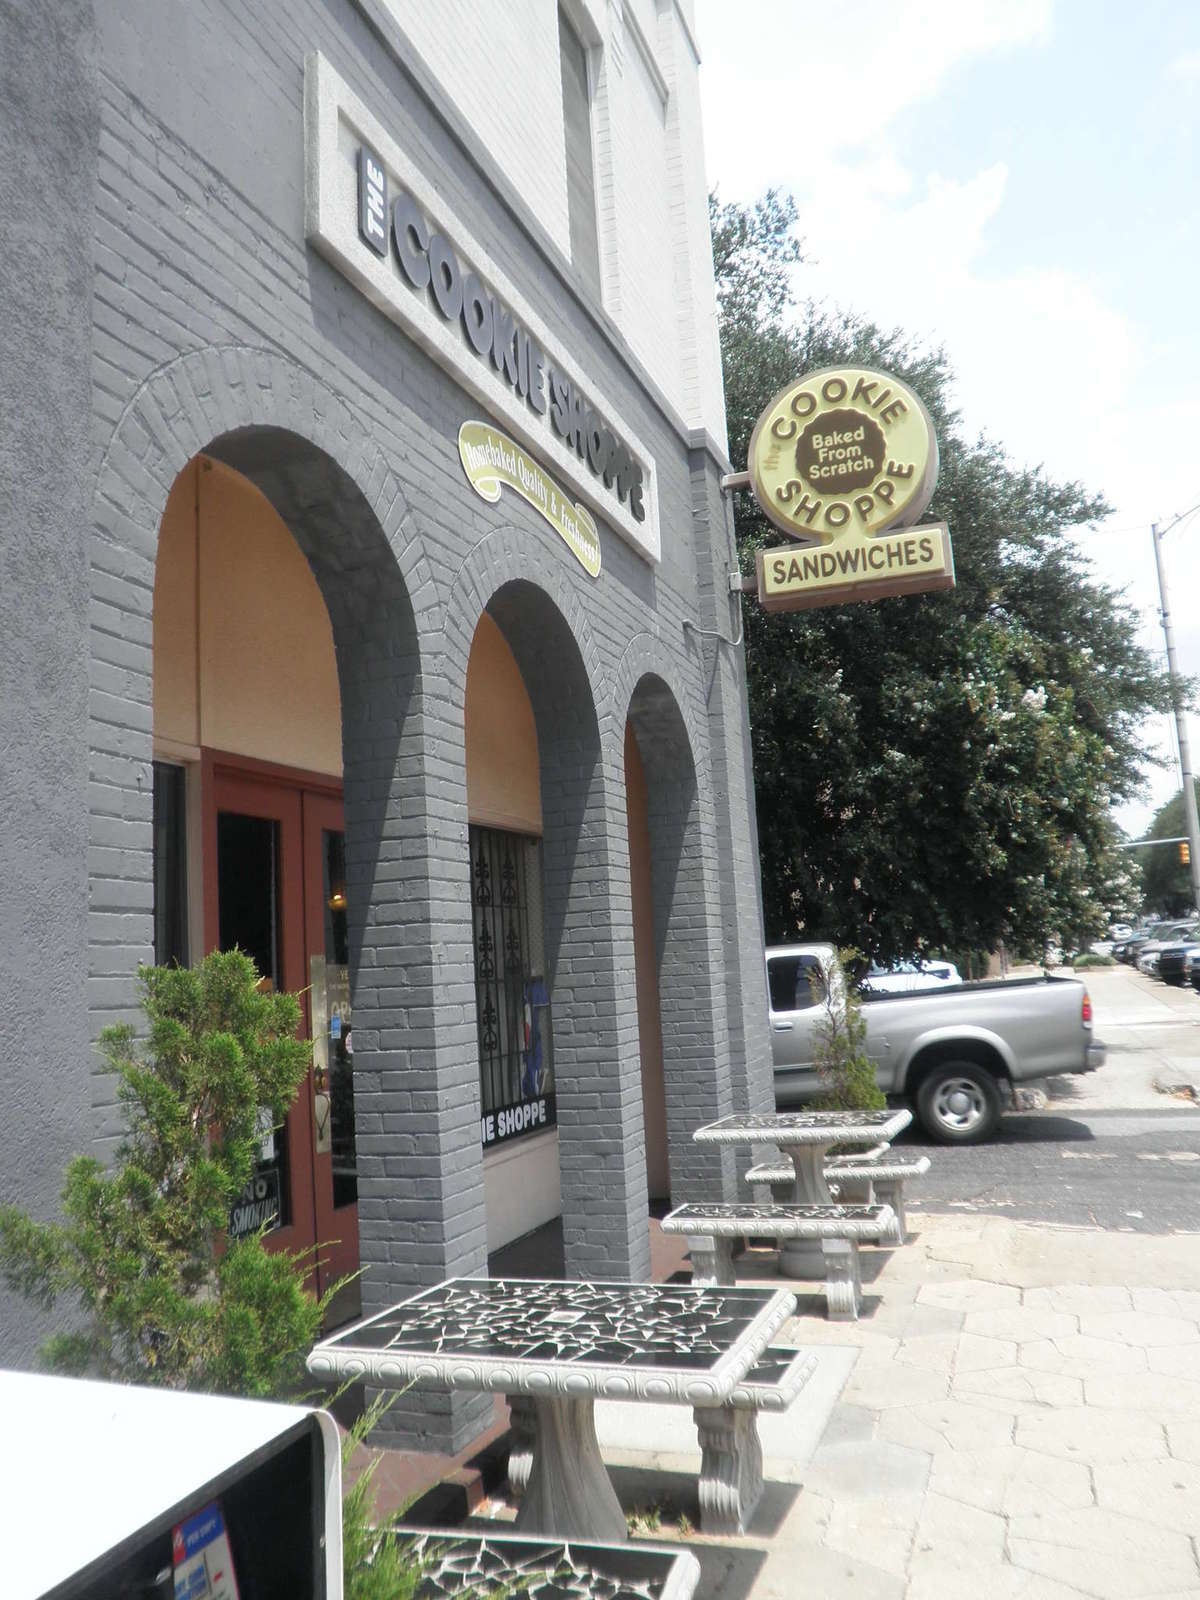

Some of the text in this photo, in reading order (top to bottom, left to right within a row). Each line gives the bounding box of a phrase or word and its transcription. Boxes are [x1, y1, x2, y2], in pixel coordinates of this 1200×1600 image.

[367, 158, 646, 523] THE COOKIE SHOPPE
[771, 377, 909, 440] COOKIE
[812, 425, 865, 449] Baked
[818, 445, 861, 463] From
[464, 435, 517, 477] Homebaked
[518, 457, 548, 511] Quality
[551, 493, 558, 516] &
[809, 455, 874, 479] Scratch
[776, 459, 914, 527] SHOPPE
[772, 537, 934, 584] SANDWICHES
[497, 1099, 546, 1137] SHOPPE
[243, 1180, 268, 1201] NO
